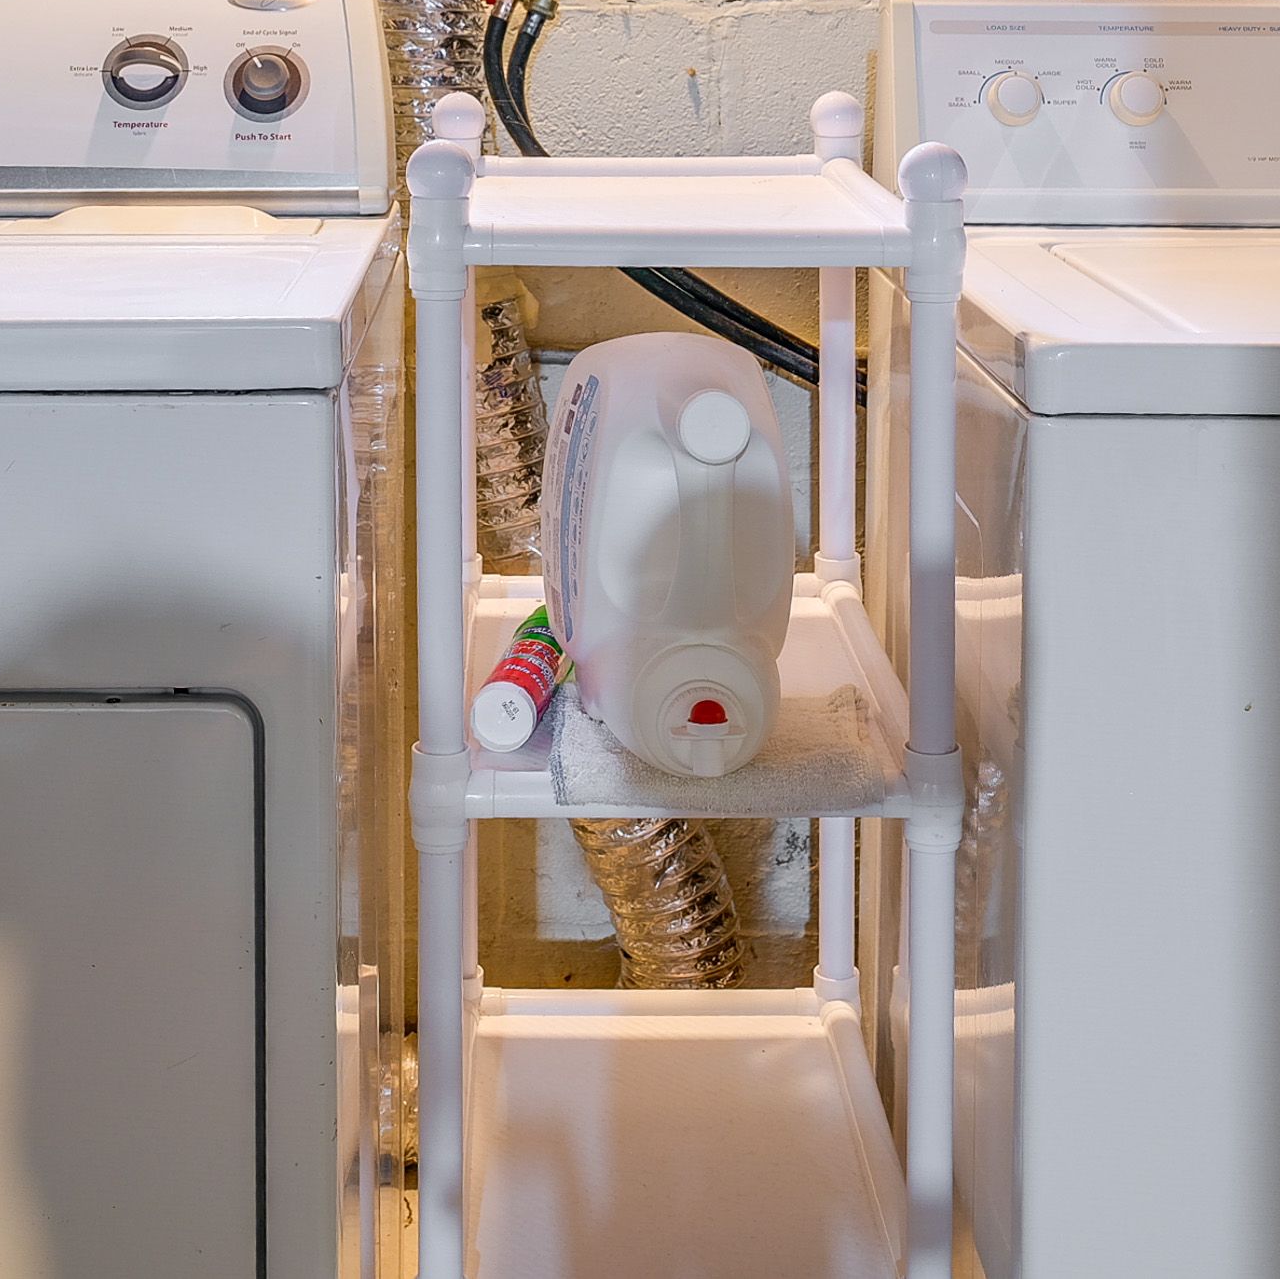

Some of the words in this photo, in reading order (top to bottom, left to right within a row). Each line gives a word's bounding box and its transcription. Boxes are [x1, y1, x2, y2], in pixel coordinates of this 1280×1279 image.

[278, 29, 298, 37] Signal
[113, 121, 168, 129] Temperature
[235, 133, 257, 141] Push
[258, 133, 269, 141] To
[270, 133, 292, 141] Start
